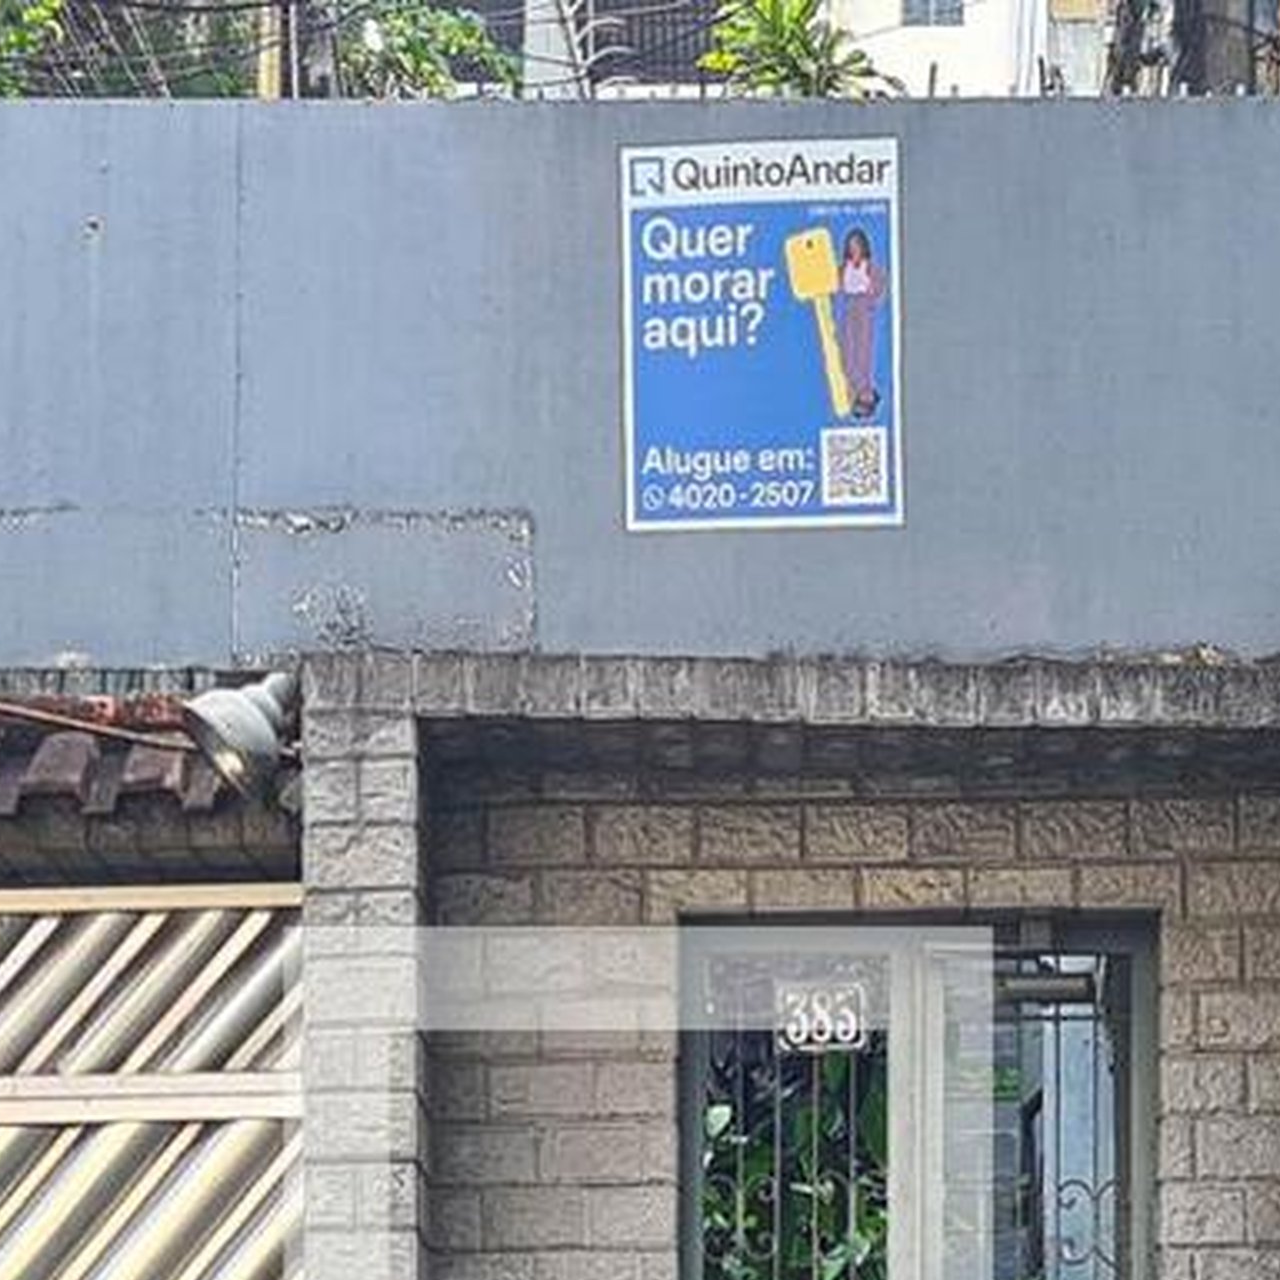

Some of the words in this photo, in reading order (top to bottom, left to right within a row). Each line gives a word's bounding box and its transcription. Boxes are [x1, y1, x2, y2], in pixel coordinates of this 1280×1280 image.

[672, 152, 891, 191] QuintoAndar
[641, 215, 753, 261] Quer
[642, 265, 775, 304] morar
[642, 302, 765, 359] aqui?
[641, 447, 751, 481] Alugue
[757, 448, 815, 472] em:
